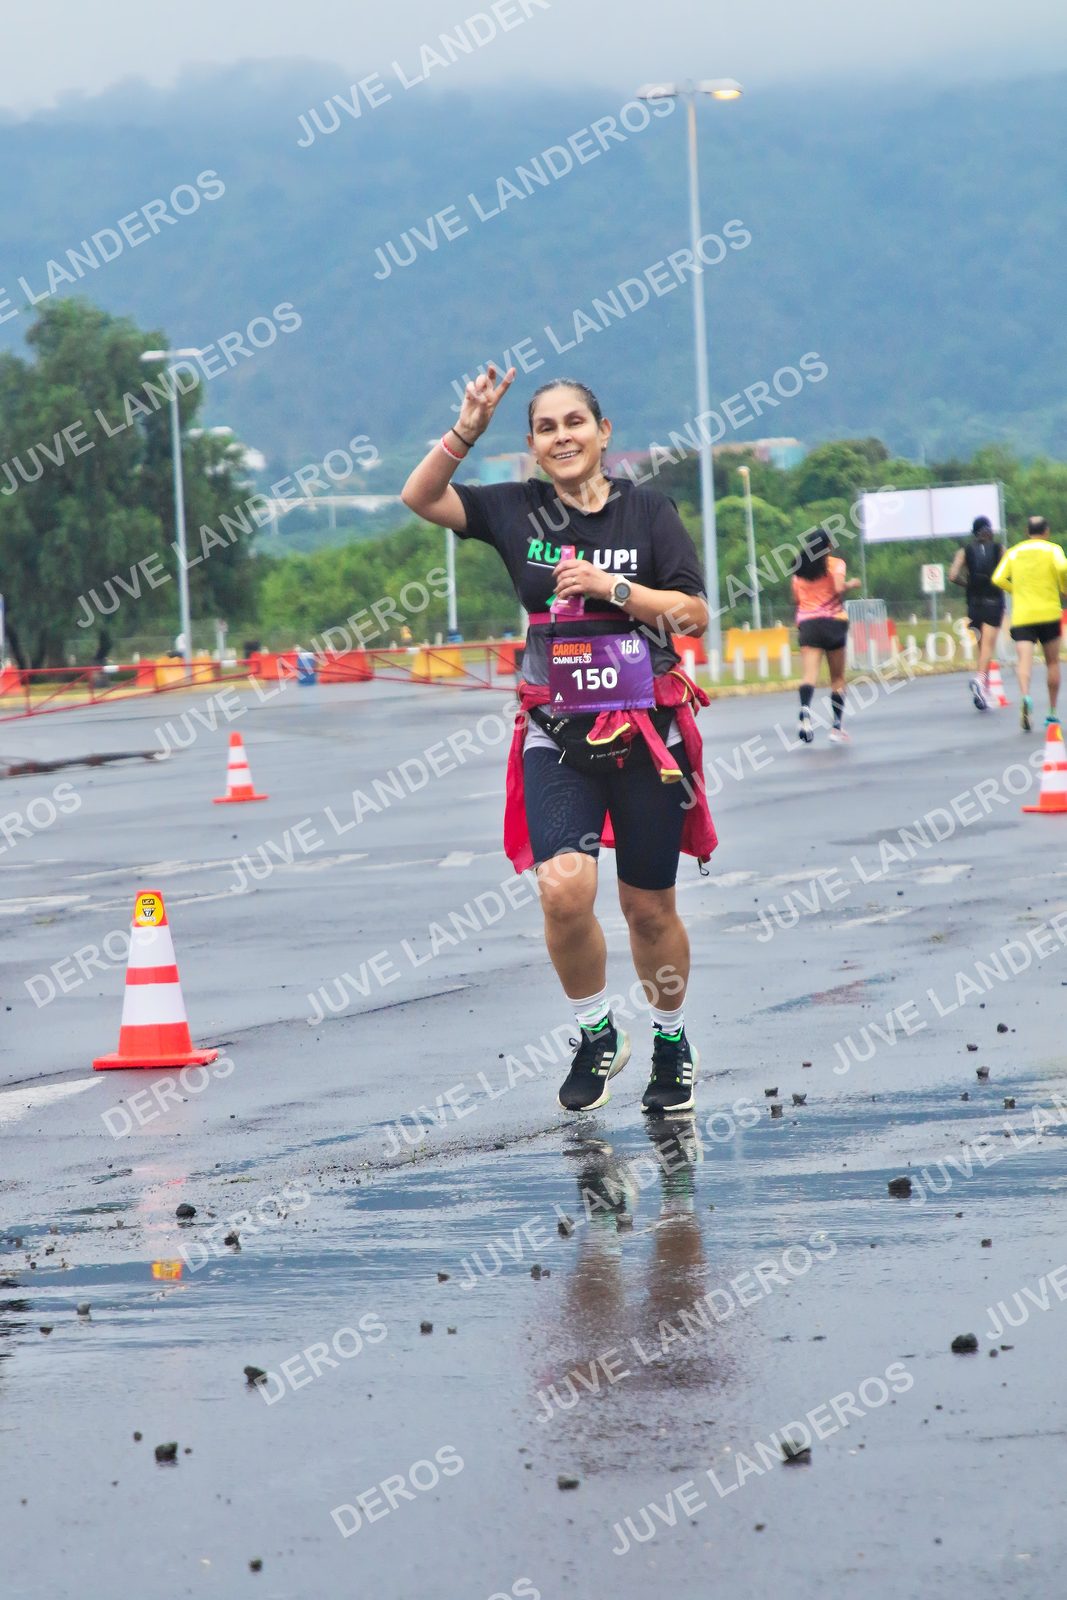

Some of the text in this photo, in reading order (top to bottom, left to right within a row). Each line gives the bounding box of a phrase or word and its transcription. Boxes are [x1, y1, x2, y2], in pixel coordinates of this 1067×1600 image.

[593, 549, 638, 570] UP!
[553, 643, 592, 656] CARRERA
[621, 639, 640, 655] 15K
[571, 667, 618, 690] 150
